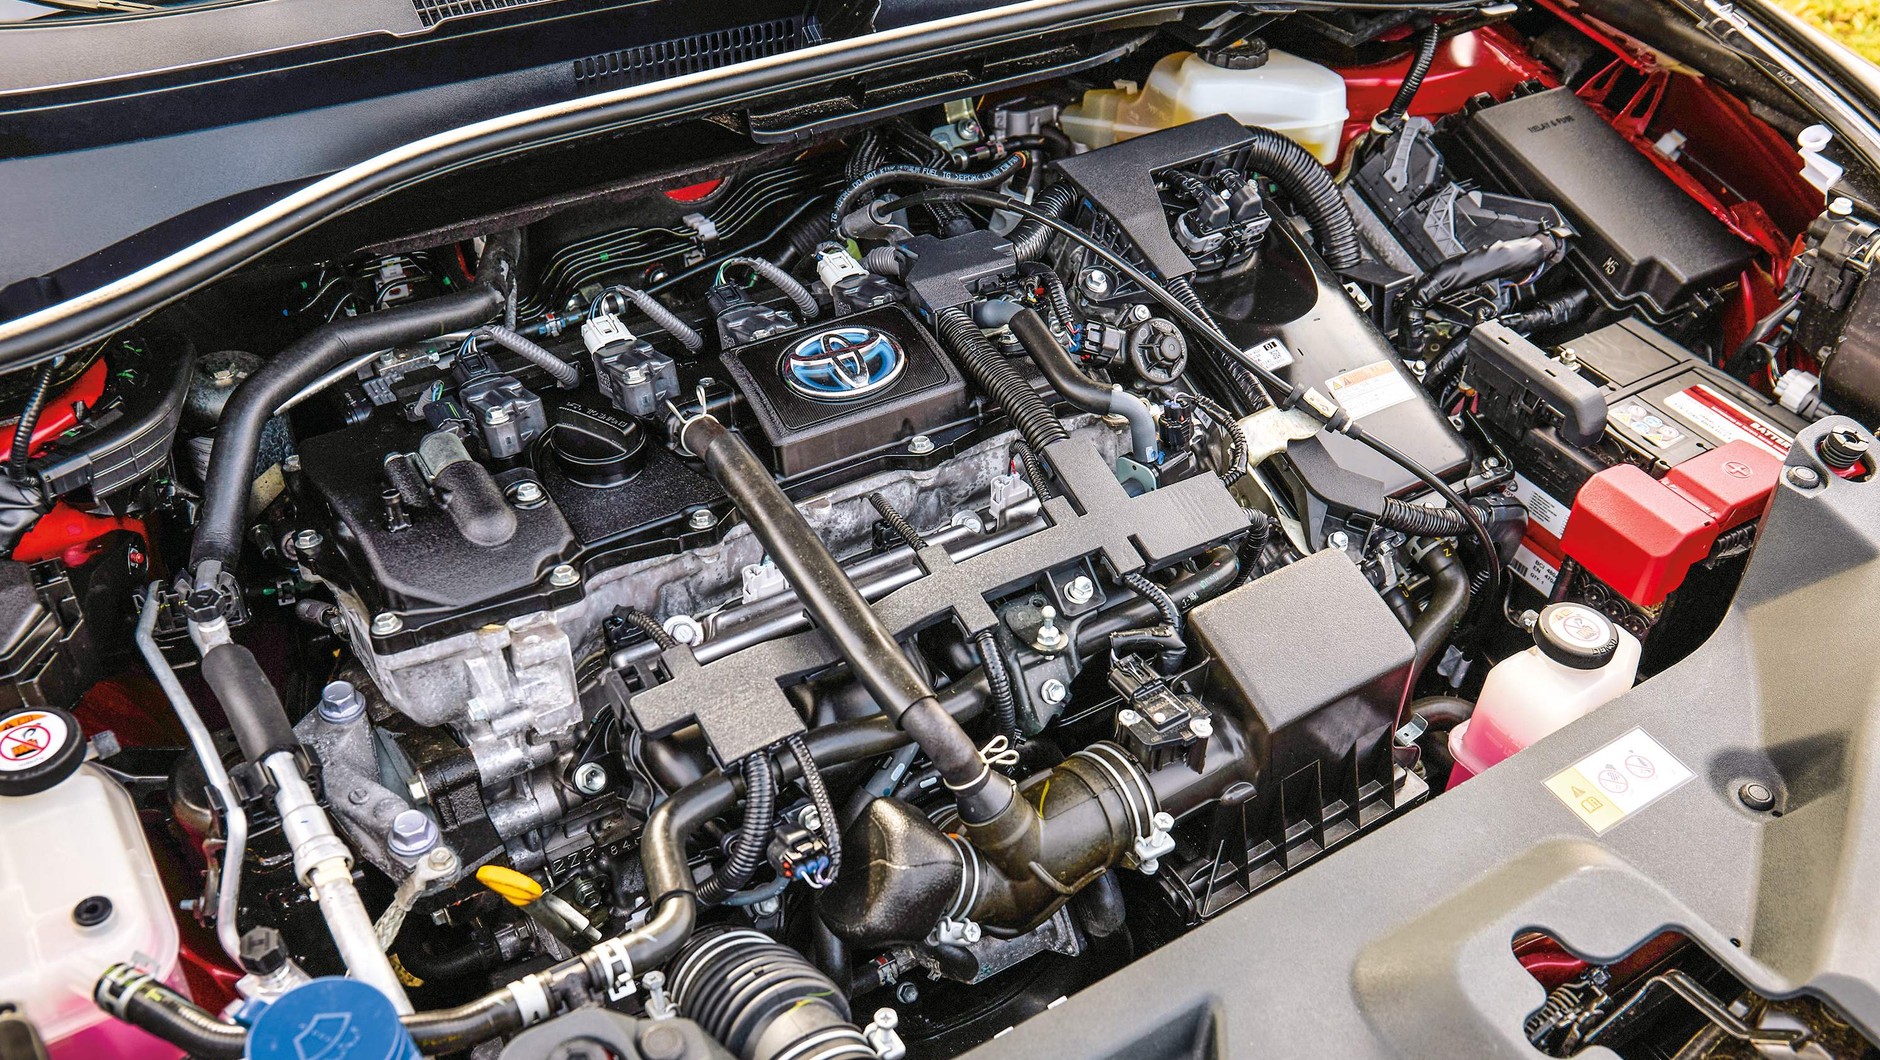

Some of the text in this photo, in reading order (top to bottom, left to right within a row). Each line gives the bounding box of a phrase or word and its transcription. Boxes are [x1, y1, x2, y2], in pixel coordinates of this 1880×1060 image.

[852, 179, 863, 190] DO
[863, 170, 877, 182] NOT
[921, 167, 939, 178] FUEL
[1749, 421, 1791, 449] BATTER
